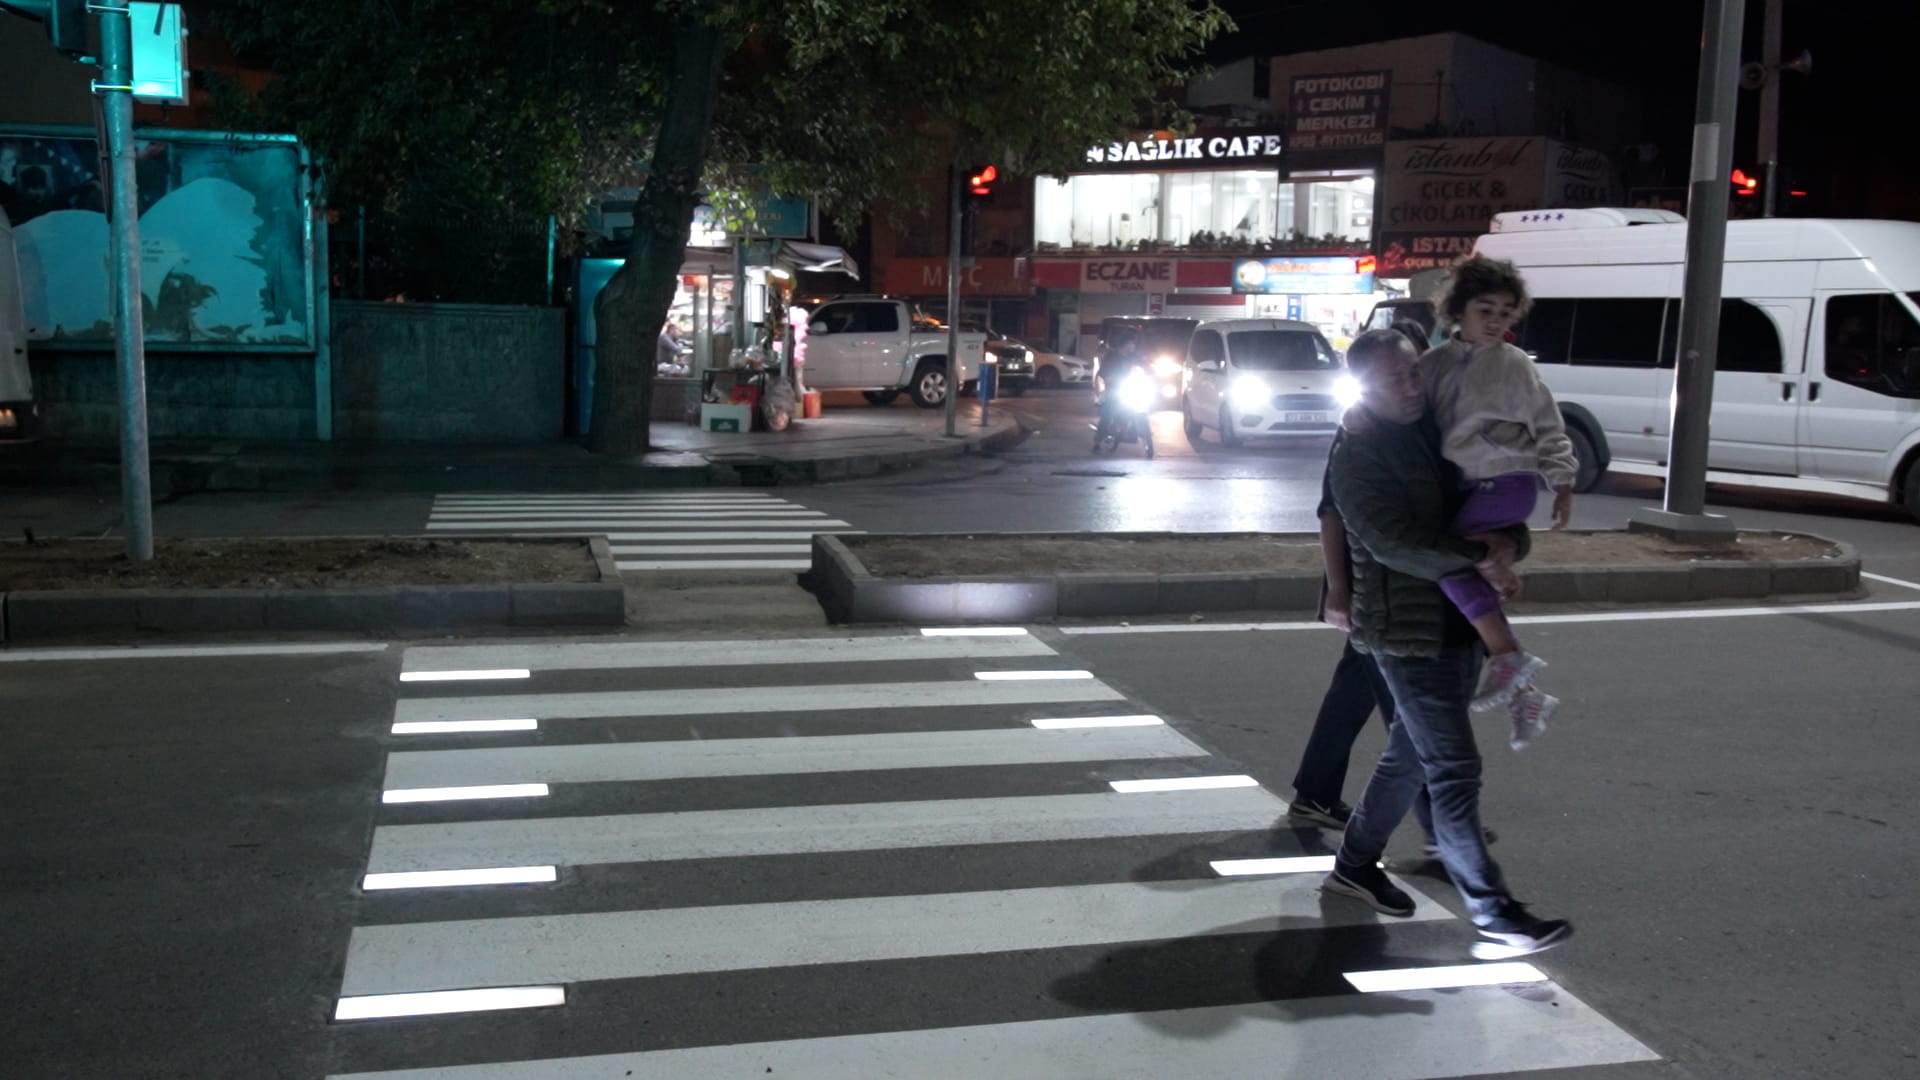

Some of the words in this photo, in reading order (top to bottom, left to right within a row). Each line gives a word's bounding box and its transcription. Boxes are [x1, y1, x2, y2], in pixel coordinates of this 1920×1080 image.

[1309, 94, 1366, 115] ÇEKİM
[1296, 112, 1377, 132] MERKEZİ
[1107, 134, 1204, 162] SAĞLIK
[1208, 135, 1281, 158] CAFE
[1490, 180, 1505, 198] &
[1086, 261, 1171, 281] ECZANE
